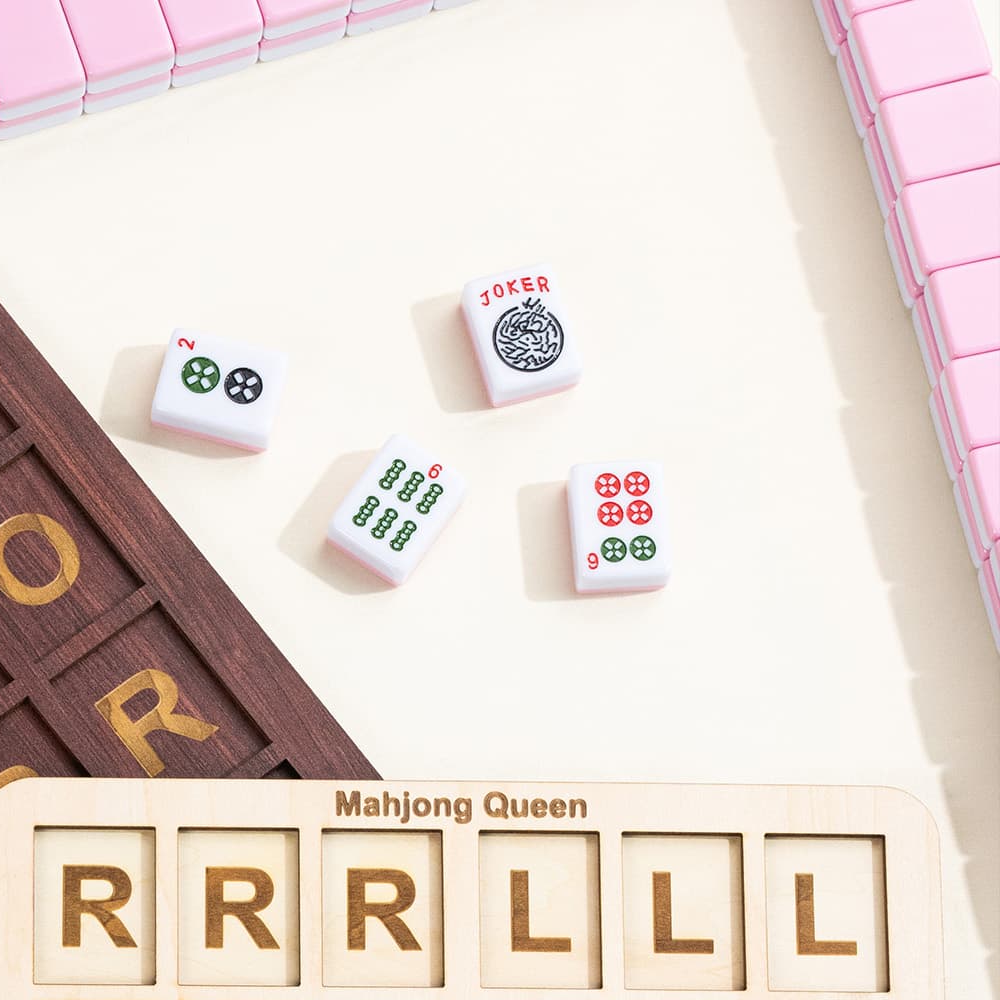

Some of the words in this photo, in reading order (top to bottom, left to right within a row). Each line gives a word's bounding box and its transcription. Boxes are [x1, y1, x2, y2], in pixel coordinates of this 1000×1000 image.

[479, 275, 550, 307] JOKER
[177, 337, 195, 351] 2
[428, 463, 443, 479] 6
[94, 668, 219, 777] R
[335, 789, 474, 824] Mahjong
[483, 791, 588, 820] Queen
[62, 865, 138, 948] R
[205, 866, 280, 949] R
[347, 868, 422, 951] R
[510, 870, 572, 953] L
[652, 871, 715, 954] L
[795, 873, 858, 956] L
